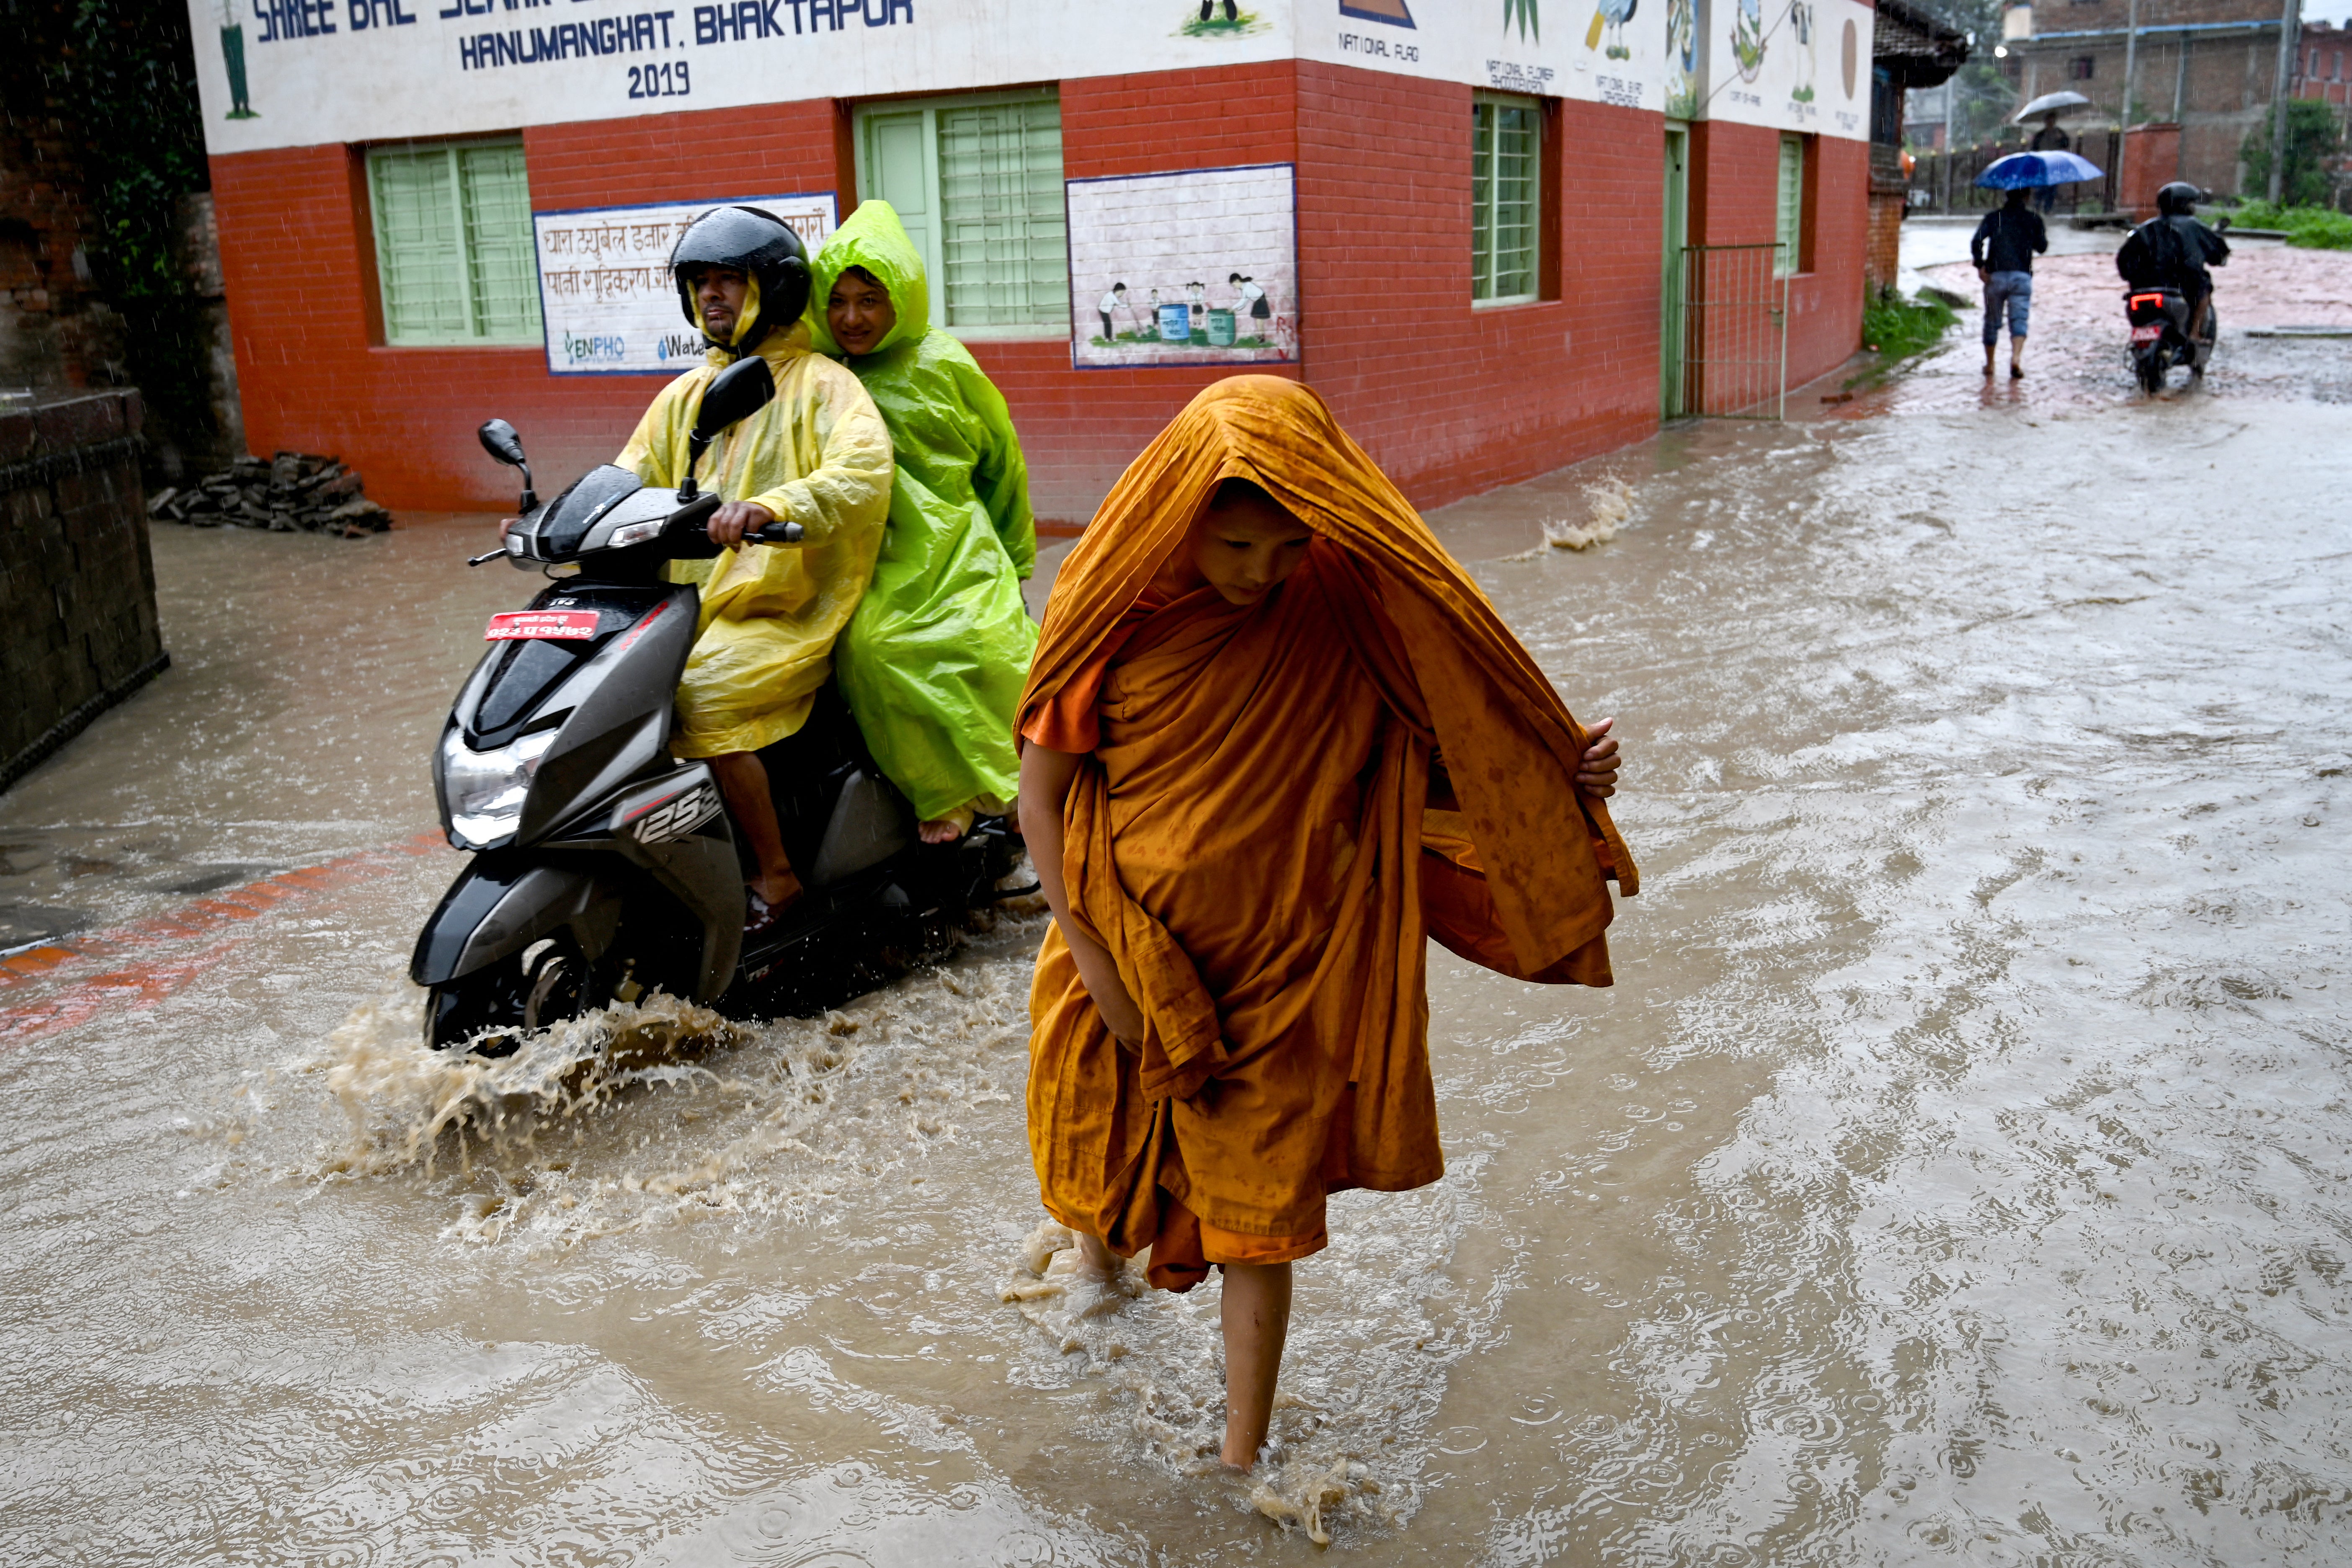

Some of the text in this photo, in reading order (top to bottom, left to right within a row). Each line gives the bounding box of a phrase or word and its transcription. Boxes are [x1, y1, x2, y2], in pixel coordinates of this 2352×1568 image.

[252, 0, 337, 42] SHREE
[694, 0, 913, 45] BHAKTAPUR
[1339, 33, 1418, 62] NATIONAL FLAG
[628, 61, 690, 99] 2019
[544, 266, 581, 296] पानी
[575, 336, 624, 358] ENPHO
[666, 334, 705, 357] Wate
[549, 598, 579, 606] TVS
[633, 787, 702, 843] 125
